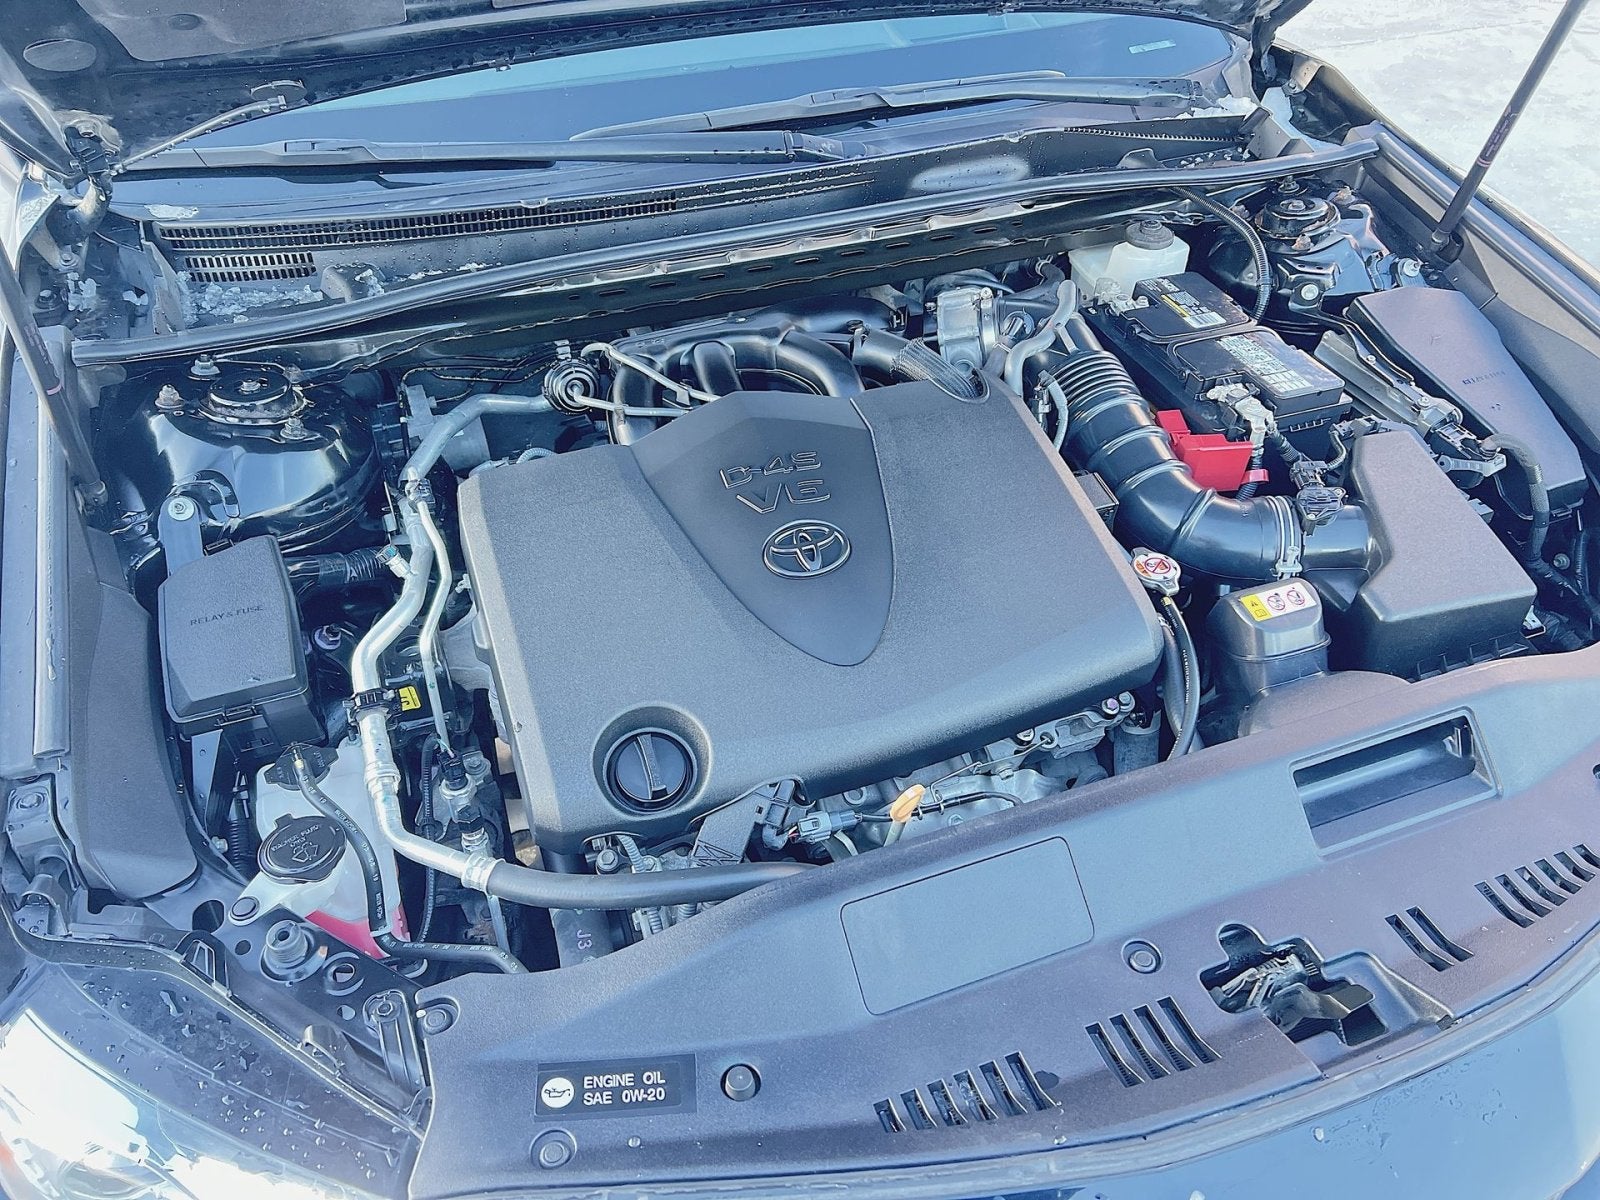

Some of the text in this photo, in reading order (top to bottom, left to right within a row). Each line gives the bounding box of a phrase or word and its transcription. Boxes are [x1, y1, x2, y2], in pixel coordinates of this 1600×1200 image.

[719, 451, 822, 489] D-4S
[735, 479, 831, 514] V6
[190, 612, 225, 626] RELAY
[236, 605, 263, 616] FUSE
[577, 929, 592, 950] J3
[583, 1071, 666, 1090] ENGINE OIL
[583, 1087, 666, 1106] SAE 0W-20
